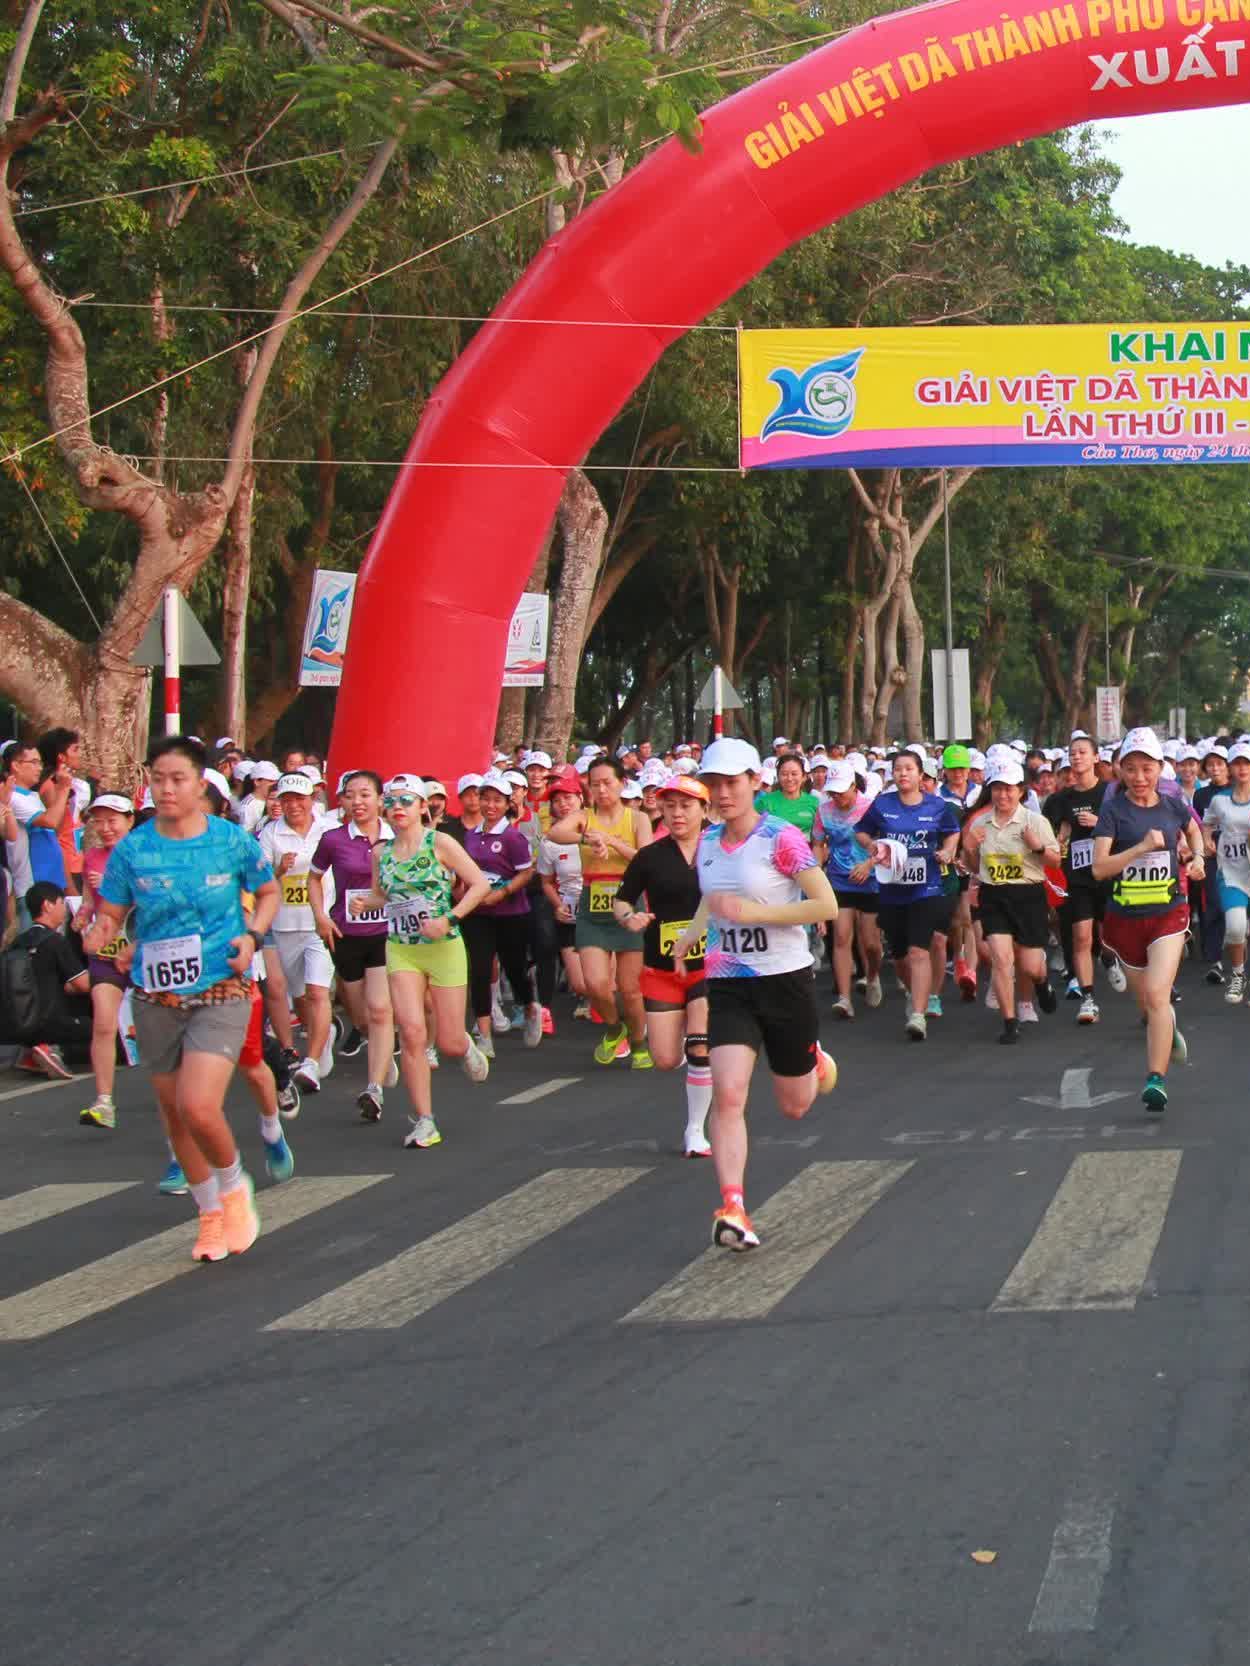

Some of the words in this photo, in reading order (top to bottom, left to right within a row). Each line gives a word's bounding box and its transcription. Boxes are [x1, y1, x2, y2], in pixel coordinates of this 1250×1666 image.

[1087, 23, 1245, 91] XUẤT
[744, 102, 826, 169] GIẢI
[817, 65, 902, 126] VIỆT
[901, 38, 958, 93] DÃ
[952, 4, 1083, 72] THÀNH
[1110, 331, 1225, 363] KHAI
[917, 374, 988, 404] GIẢI
[999, 373, 1077, 409] VIỆT
[1088, 370, 1138, 401] DÃ
[1025, 407, 1096, 438] LẦN
[1104, 404, 1184, 437] THỨ
[1194, 411, 1225, 436] III
[1081, 443, 1117, 459] Cần
[1162, 444, 1205, 461] ngày
[1206, 444, 1230, 458] 24
[1127, 866, 1169, 881] 2102
[147, 956, 201, 989] 1655
